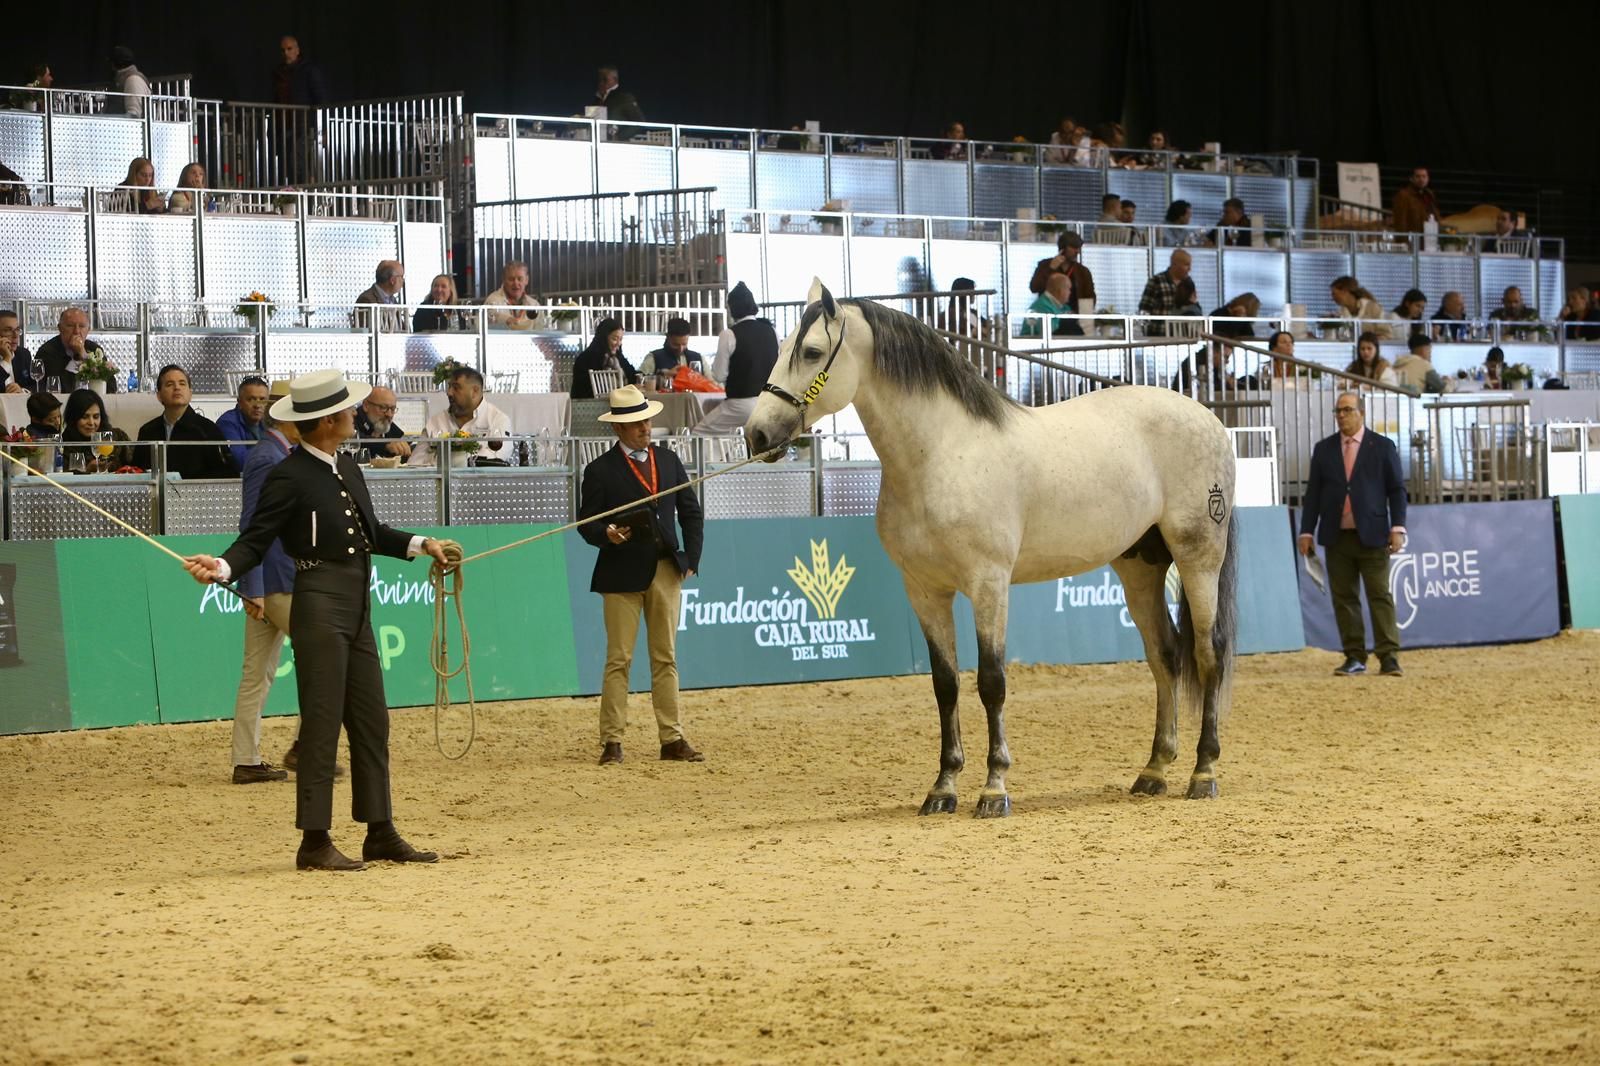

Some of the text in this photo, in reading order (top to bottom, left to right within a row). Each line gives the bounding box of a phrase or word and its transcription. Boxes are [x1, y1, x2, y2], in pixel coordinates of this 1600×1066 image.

[805, 371, 829, 401] 1012
[1422, 550, 1480, 577] PRE
[1424, 577, 1481, 598] ANCCE
[677, 586, 808, 631] Fundación
[755, 618, 876, 648] CAJA RURAL
[792, 644, 849, 661] DEL SUR
